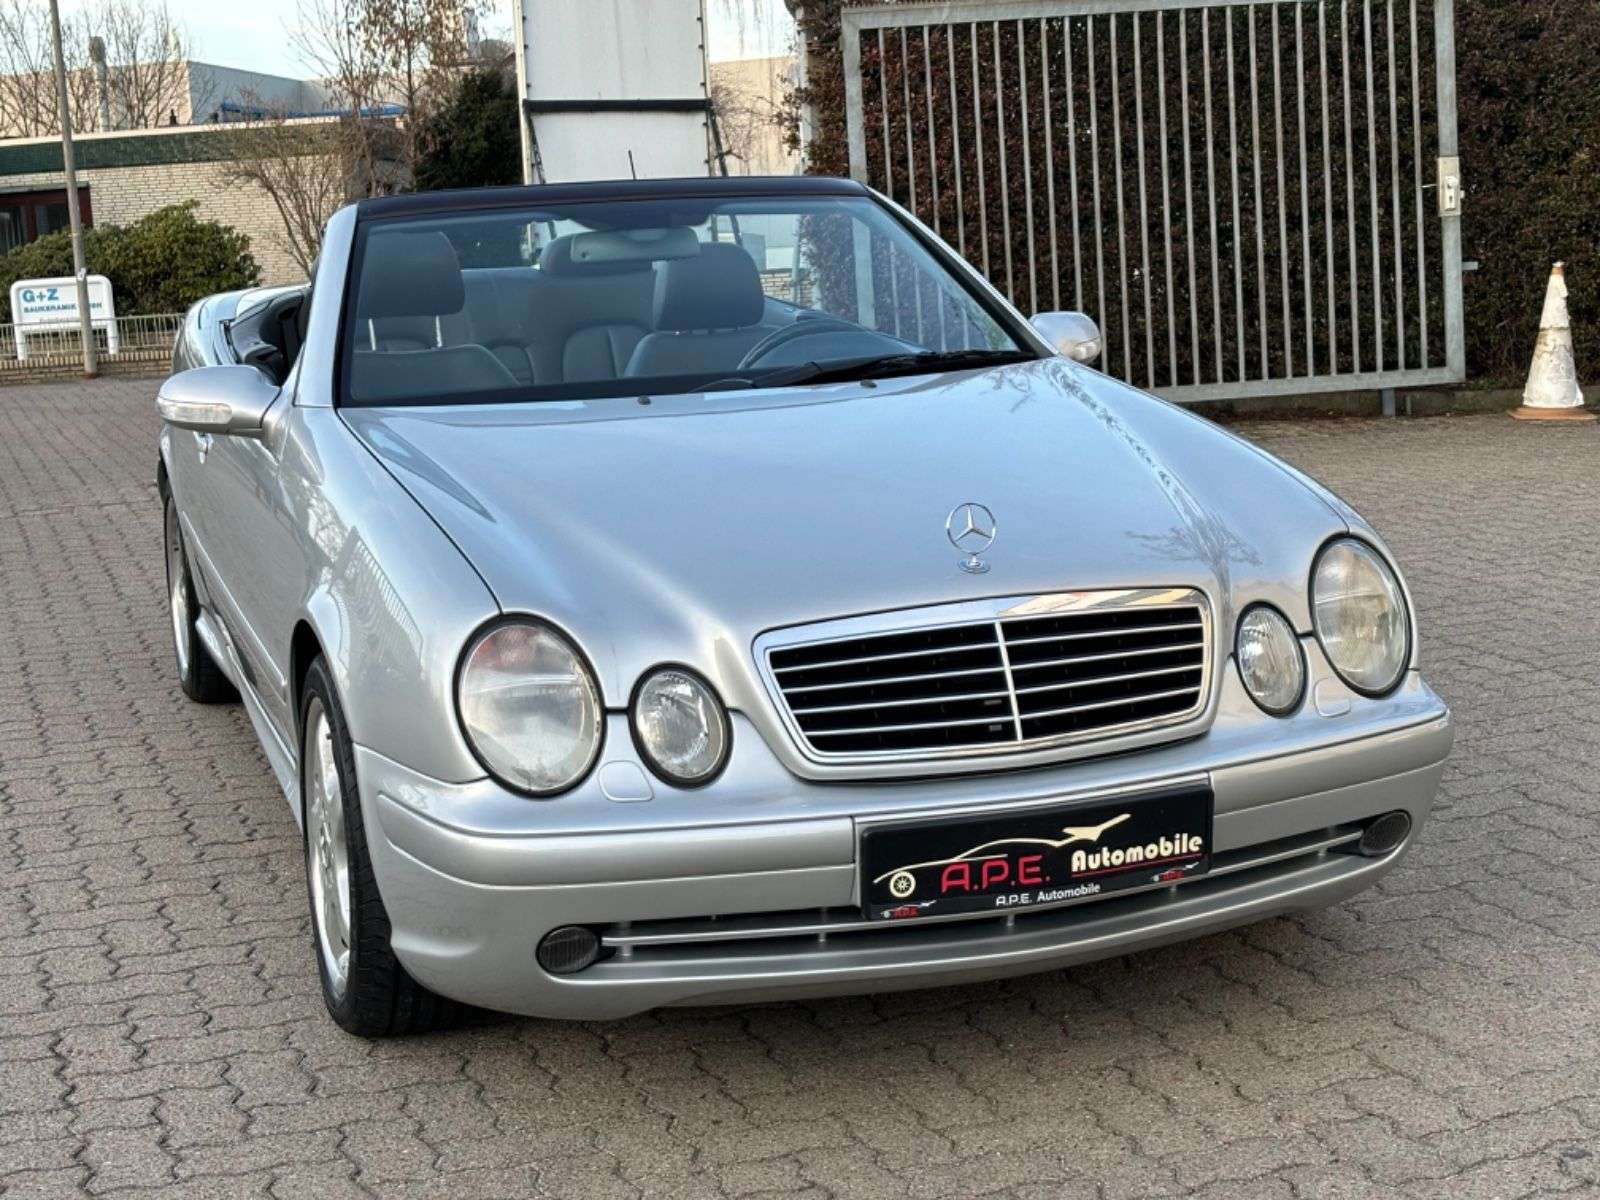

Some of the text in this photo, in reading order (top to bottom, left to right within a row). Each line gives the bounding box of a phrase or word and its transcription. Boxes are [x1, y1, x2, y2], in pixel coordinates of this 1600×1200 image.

[22, 287, 59, 302] G+Z
[941, 834, 1203, 893] A.P.E. Automobile
[995, 883, 1101, 907] A.P.E. Automobile
